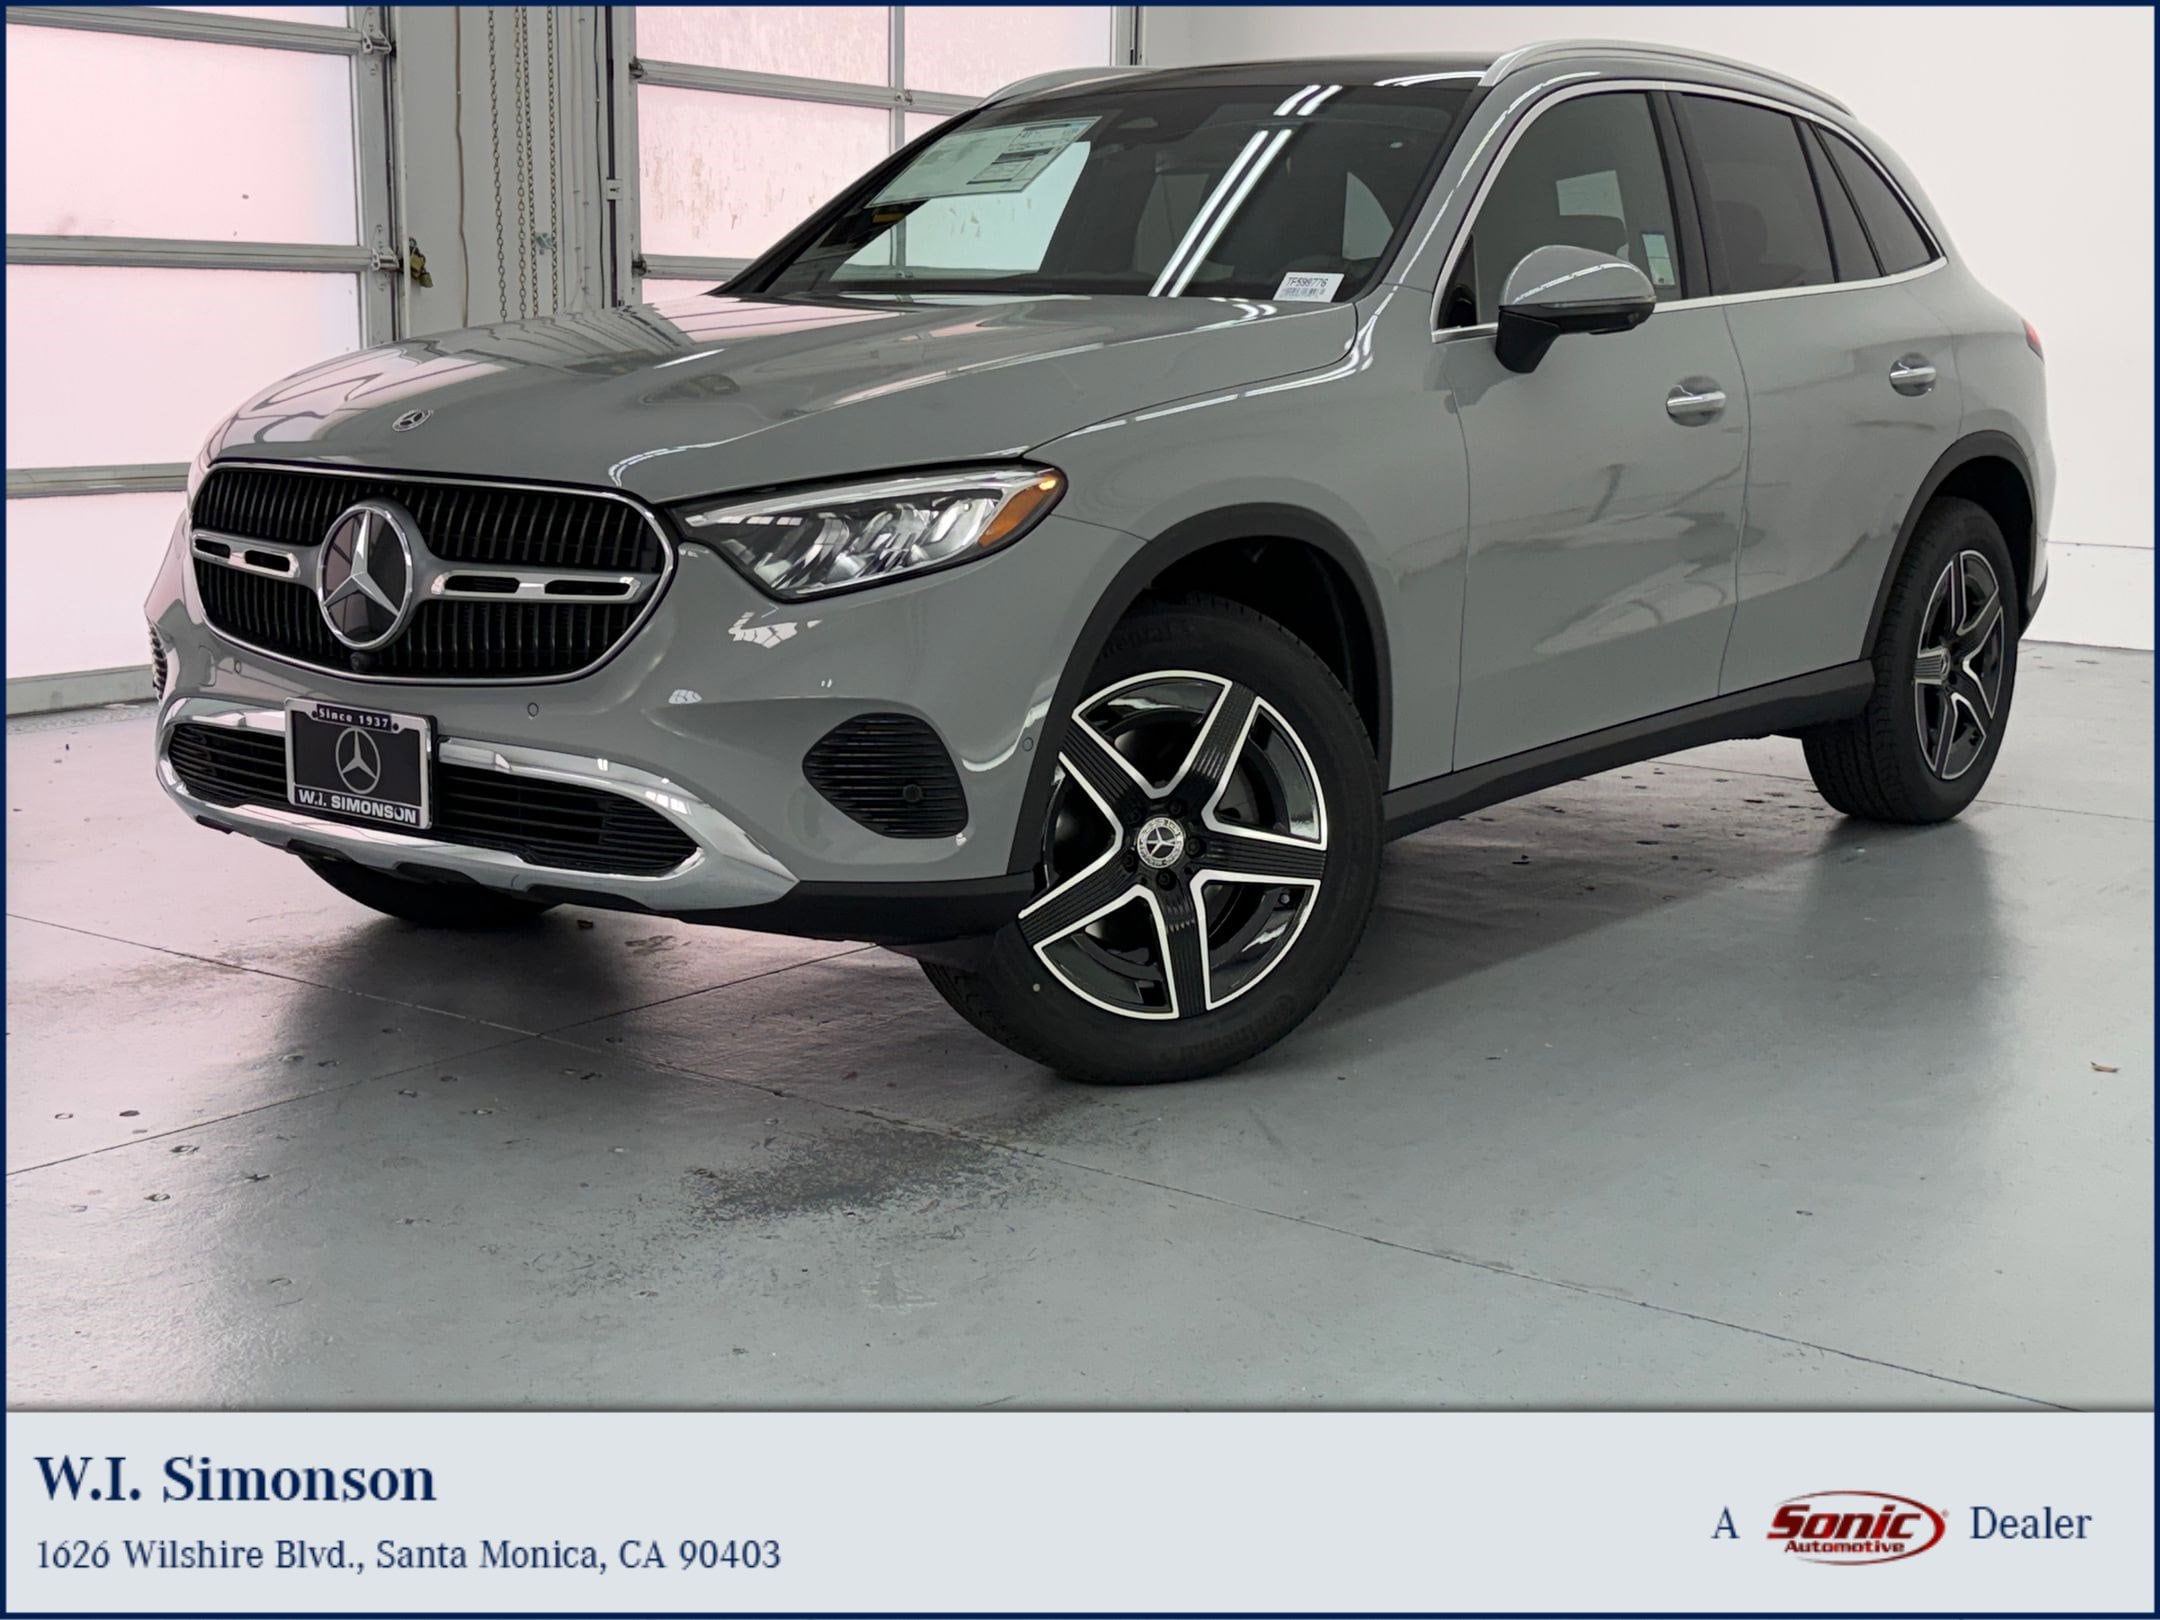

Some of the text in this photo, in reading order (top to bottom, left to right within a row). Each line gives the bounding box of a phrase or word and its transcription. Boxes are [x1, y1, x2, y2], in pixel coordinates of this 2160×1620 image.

[318, 707, 390, 728] Since 1937
[331, 795, 417, 825] SIMONSON
